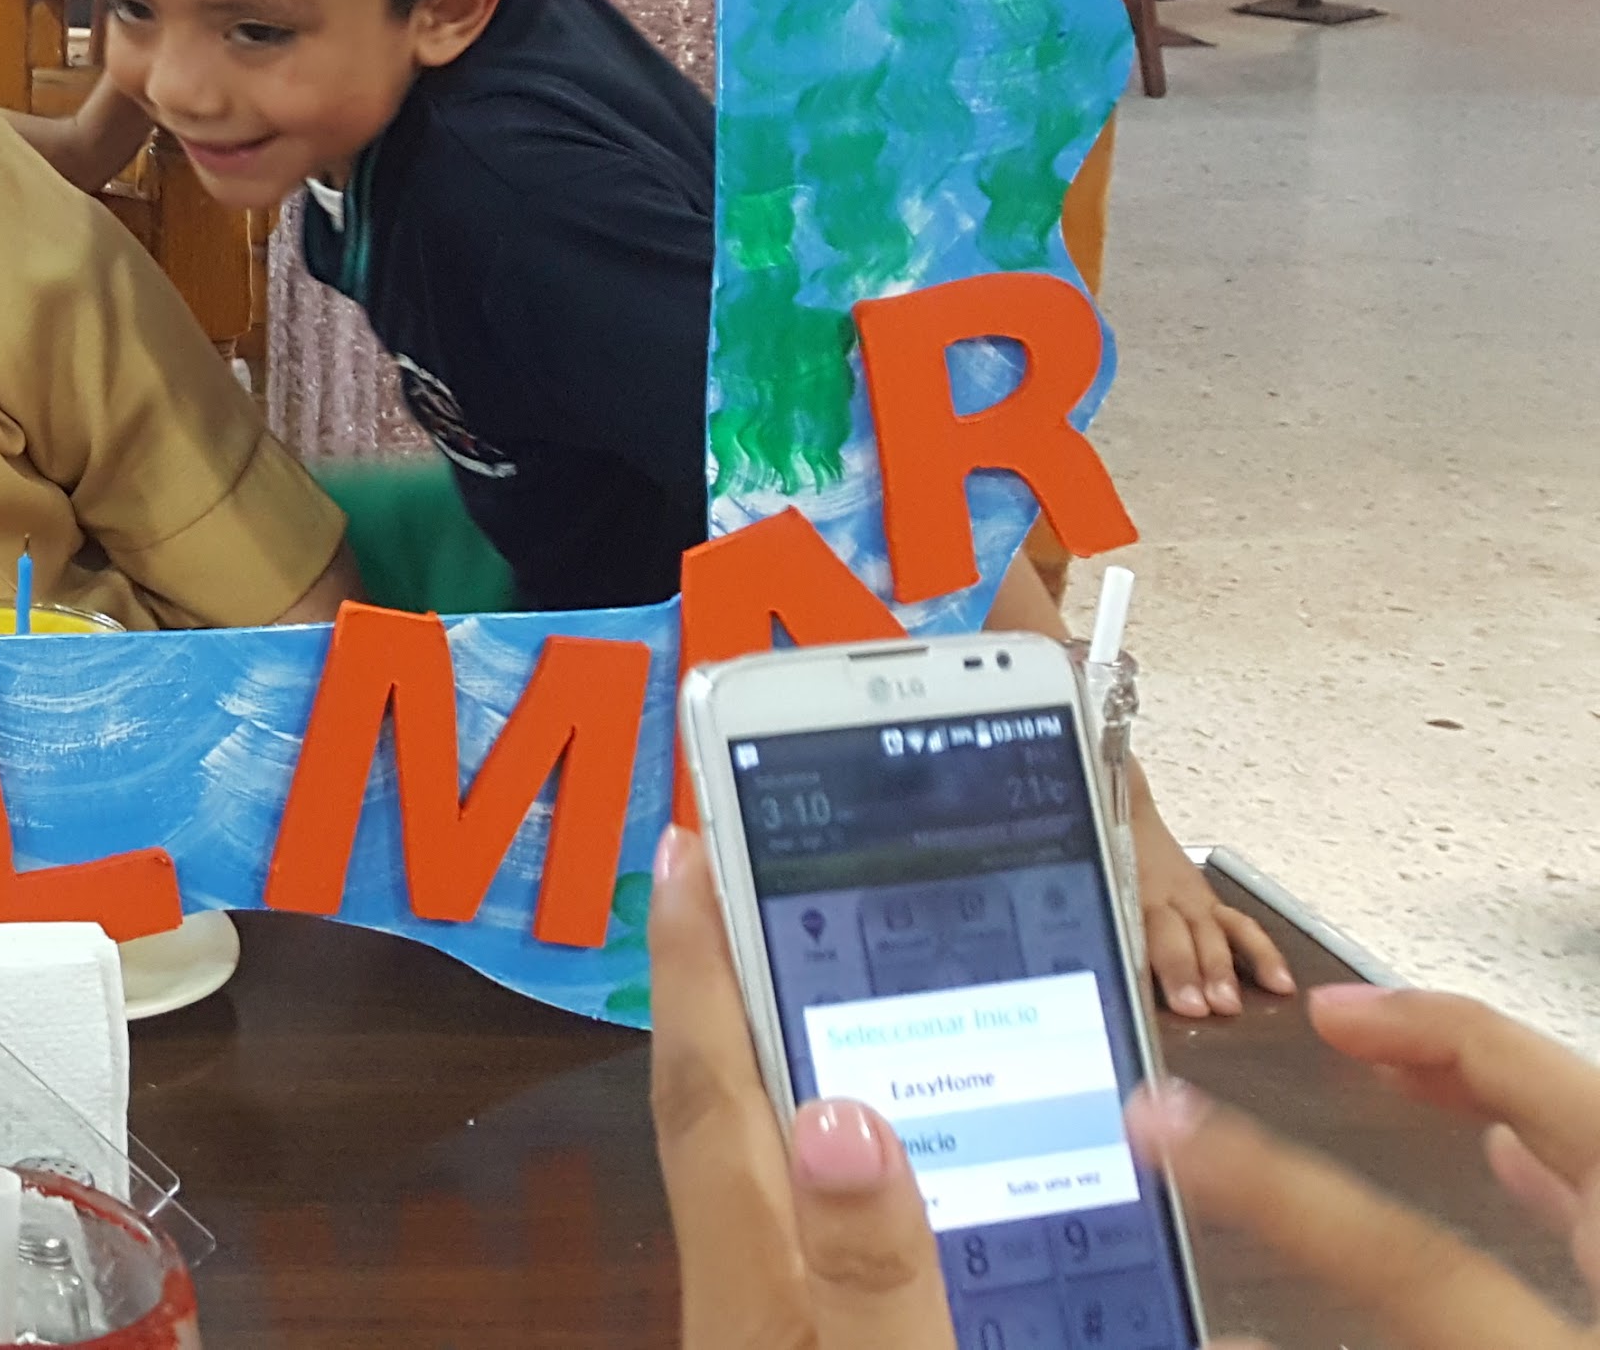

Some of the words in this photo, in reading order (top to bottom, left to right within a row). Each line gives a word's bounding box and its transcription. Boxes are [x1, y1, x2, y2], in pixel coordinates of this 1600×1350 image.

[826, 1012, 967, 1047] Seleccionar
[973, 1003, 1039, 1032] Inicio
[890, 1070, 997, 1101] EasyHome
[963, 1233, 991, 1279] 8
[1062, 1219, 1092, 1263] 9
